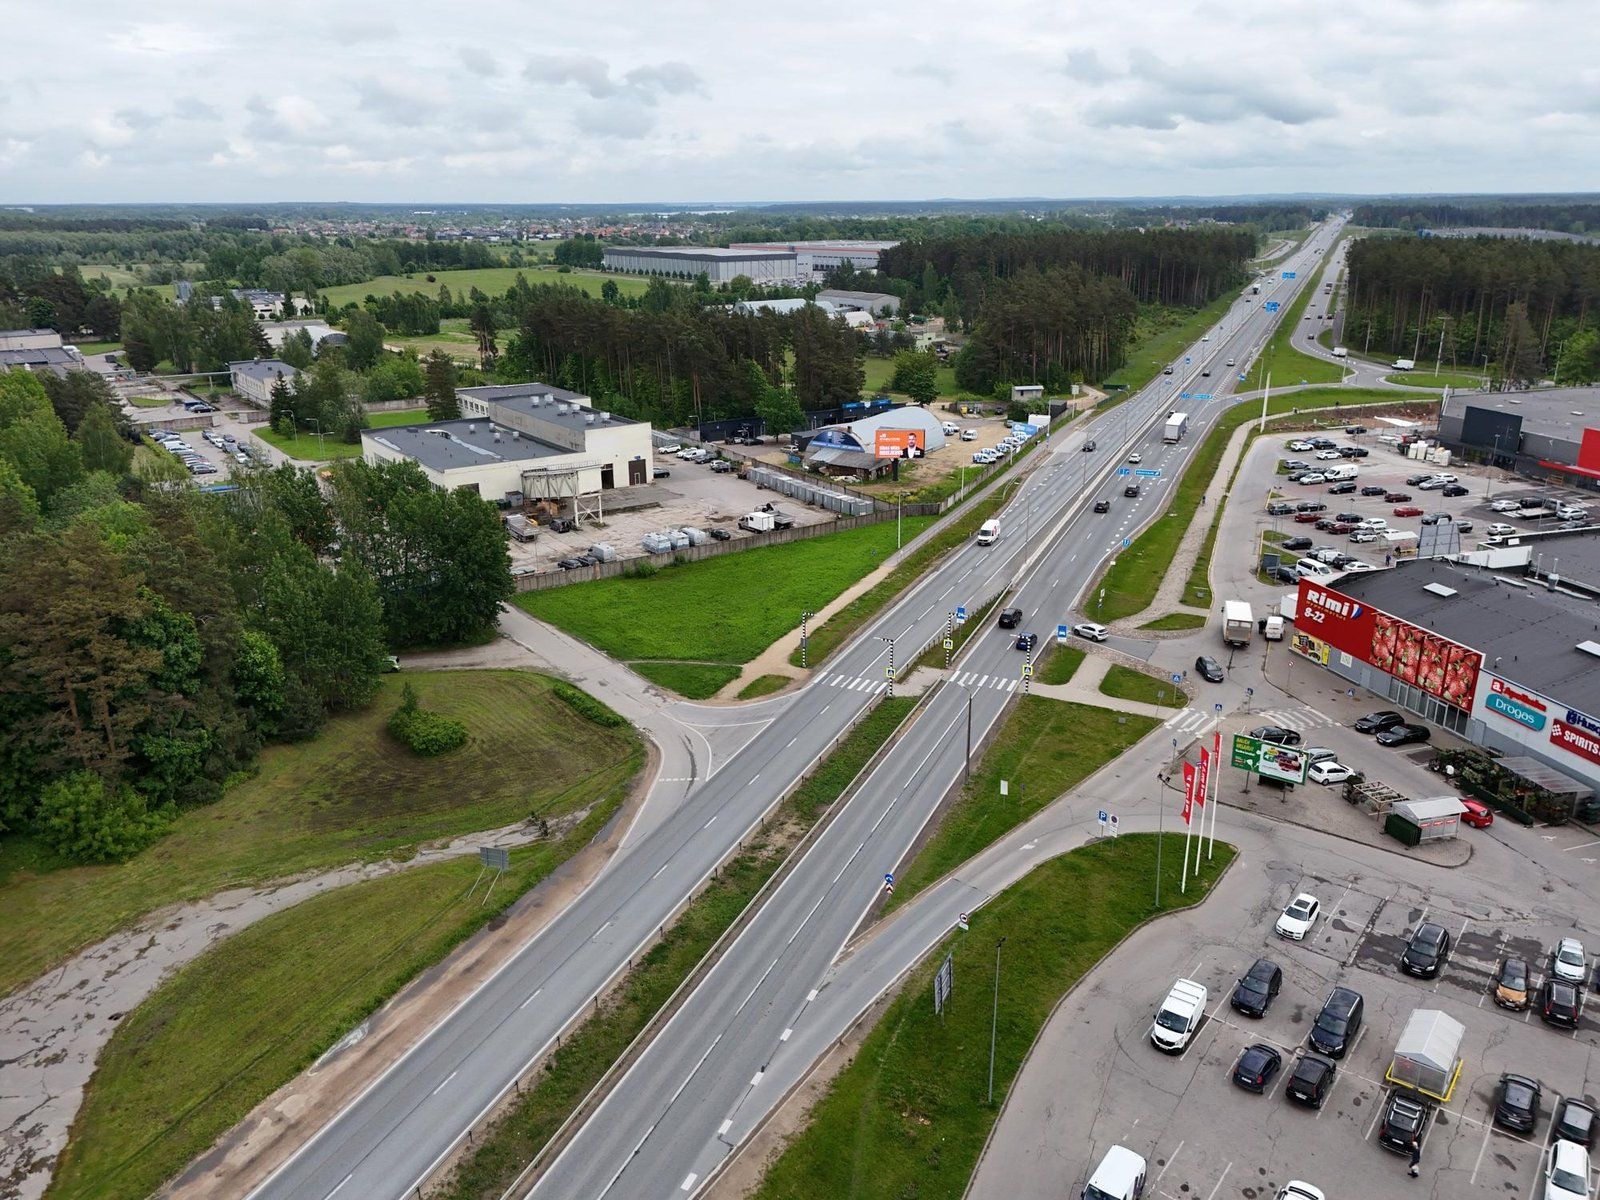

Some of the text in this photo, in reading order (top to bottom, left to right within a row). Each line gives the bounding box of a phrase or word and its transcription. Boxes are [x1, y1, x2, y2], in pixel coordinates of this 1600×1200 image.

[1304, 607, 1325, 623] 8-22
[1307, 589, 1350, 617] Rimi
[1495, 698, 1535, 724] Drogas
